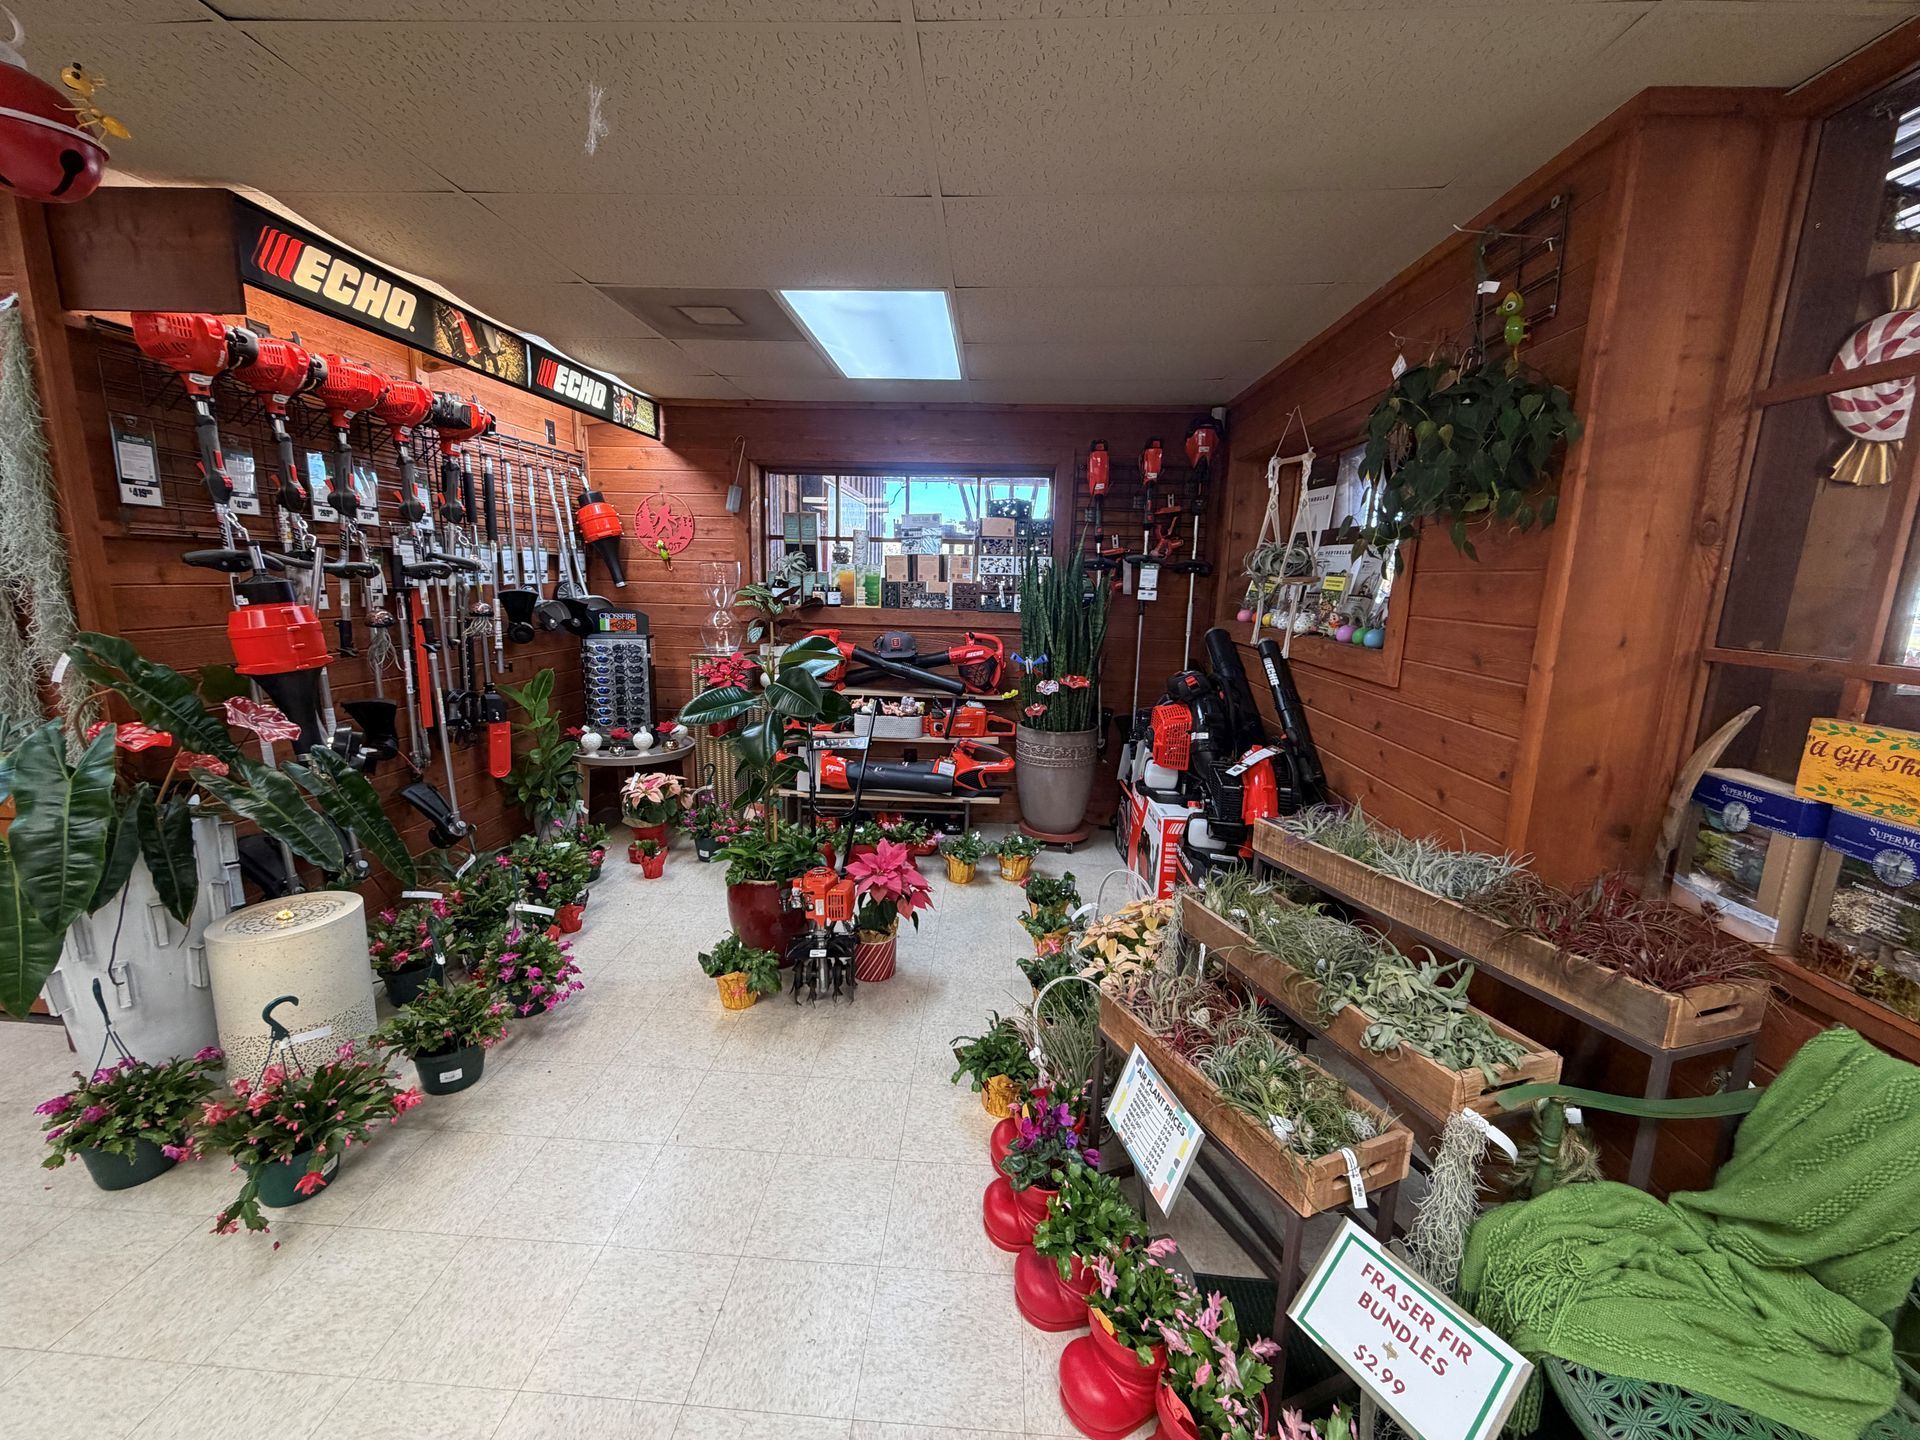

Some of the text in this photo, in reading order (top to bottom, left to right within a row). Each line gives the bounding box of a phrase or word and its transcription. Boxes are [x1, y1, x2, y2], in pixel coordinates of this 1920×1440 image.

[293, 245, 417, 330] ECHO
[553, 365, 606, 409] ECHO
[217, 522, 230, 547] ECHO
[293, 528, 303, 551] ECHO
[339, 529, 348, 550] ECHO
[1265, 662, 1280, 686] ECHO
[1833, 745, 1877, 771] Gift
[1136, 1065, 1186, 1138] AIR PLANT PRICES
[1357, 1291, 1449, 1376] BUNDLES
[1360, 1263, 1473, 1366] FRASER FIR
[1353, 1344, 1406, 1395] $2.99
